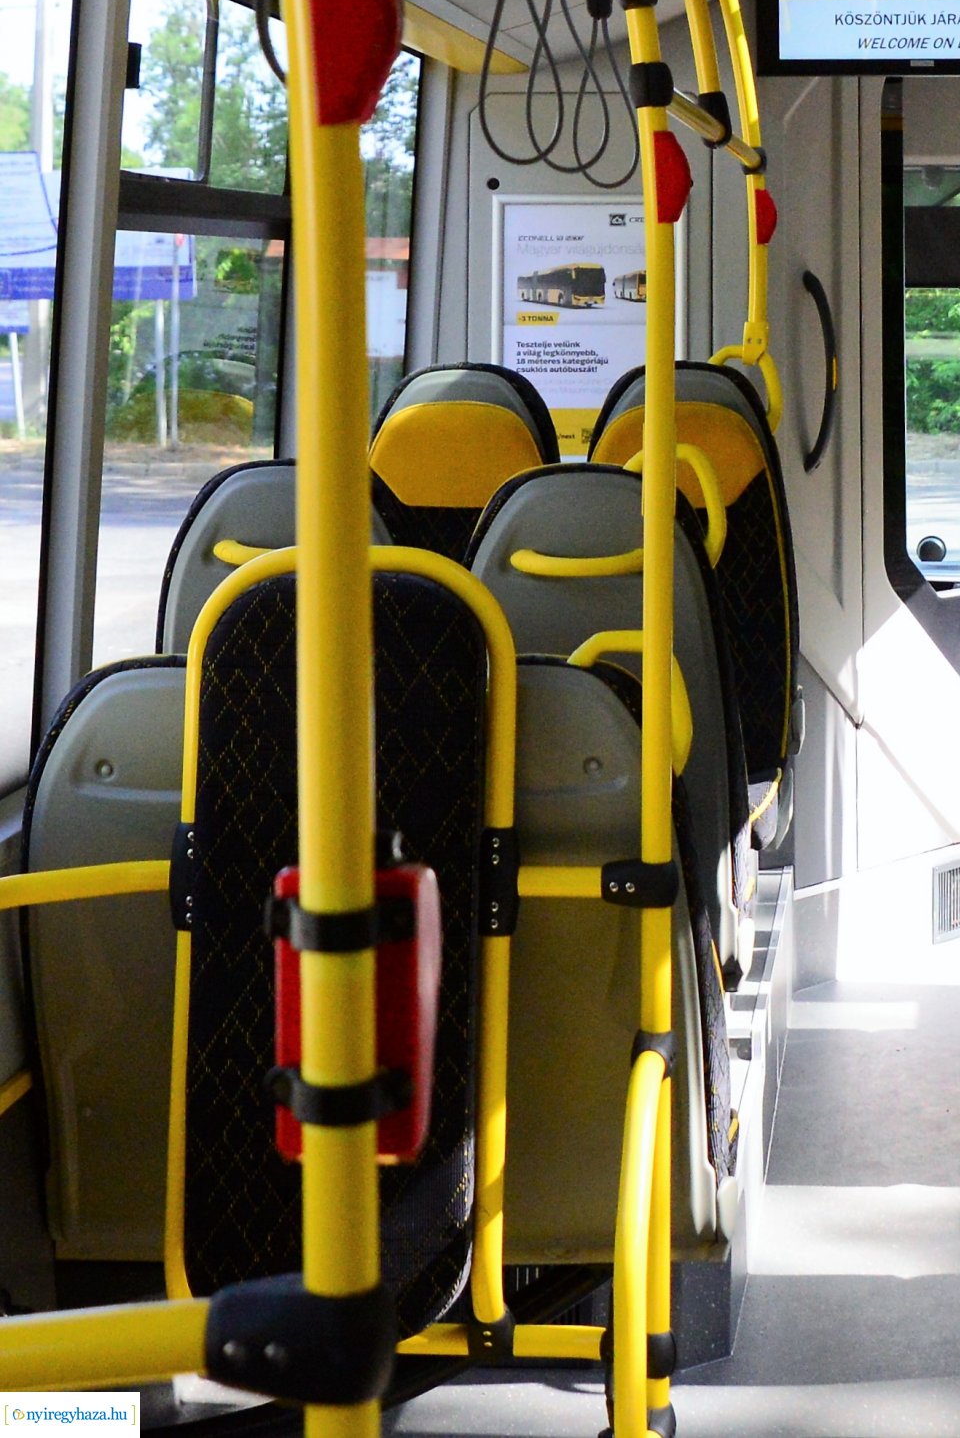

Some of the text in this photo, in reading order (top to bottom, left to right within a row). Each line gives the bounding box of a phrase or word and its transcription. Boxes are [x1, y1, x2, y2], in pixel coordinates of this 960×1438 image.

[834, 10, 927, 26] KÖSZÖNTJÜK
[858, 37, 930, 49] WELCOME
[933, 37, 955, 49] ON
[628, 216, 645, 224] CRE
[566, 242, 646, 257] világújdonsá
[523, 349, 542, 359] világ
[543, 350, 599, 359] legkönnyebb,
[516, 366, 598, 374] csuklós autóbuszát!
